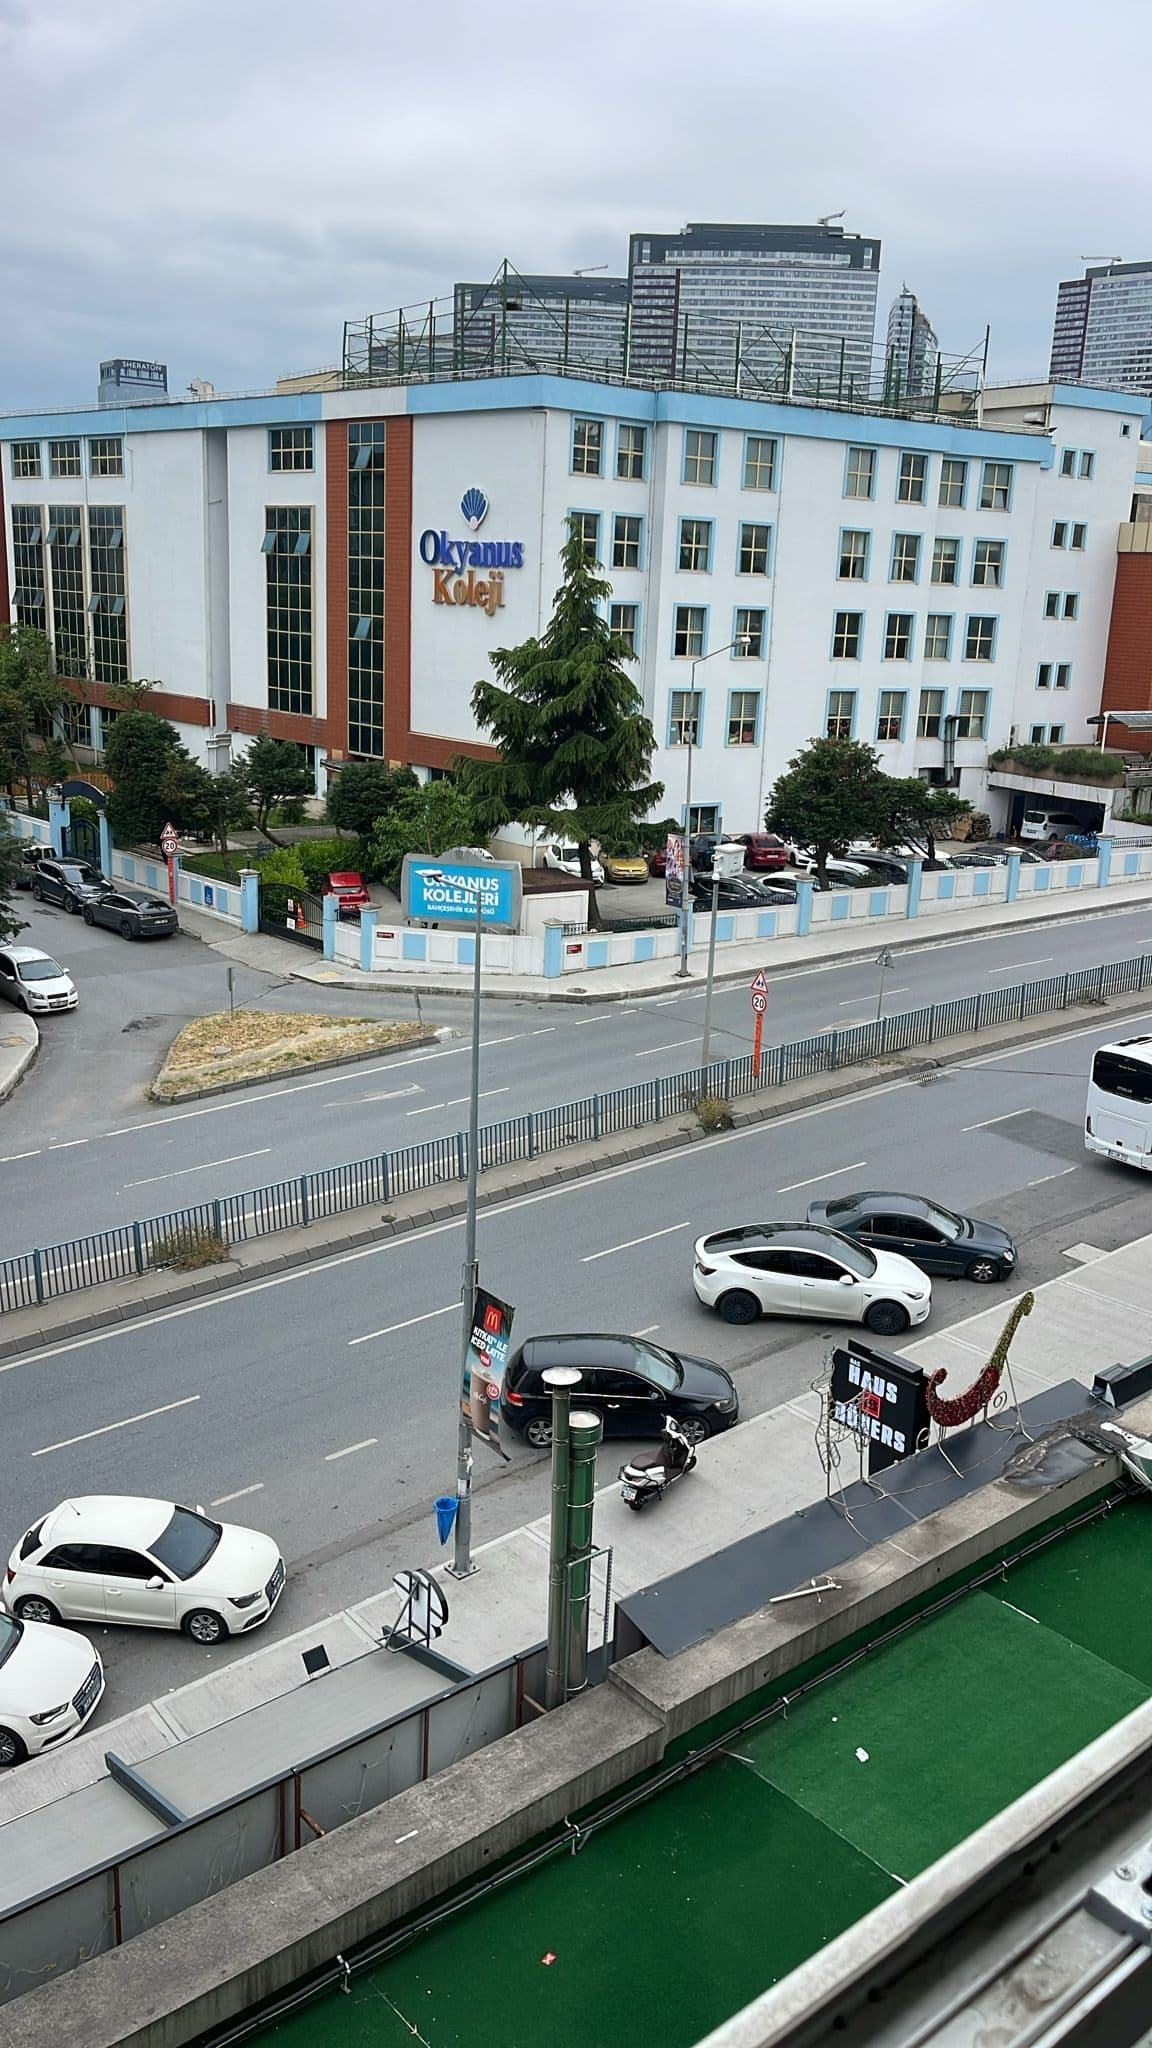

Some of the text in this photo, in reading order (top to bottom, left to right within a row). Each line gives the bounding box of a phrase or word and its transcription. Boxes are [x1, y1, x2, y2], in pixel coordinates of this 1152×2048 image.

[122, 361, 162, 371] SHERATON
[420, 529, 523, 574] Okyanus
[432, 567, 505, 616] Koleji
[165, 842, 175, 850] 20
[754, 997, 764, 1009] 20
[471, 1334, 506, 1362] ICED LATTE
[849, 1364, 898, 1403] HAUS
